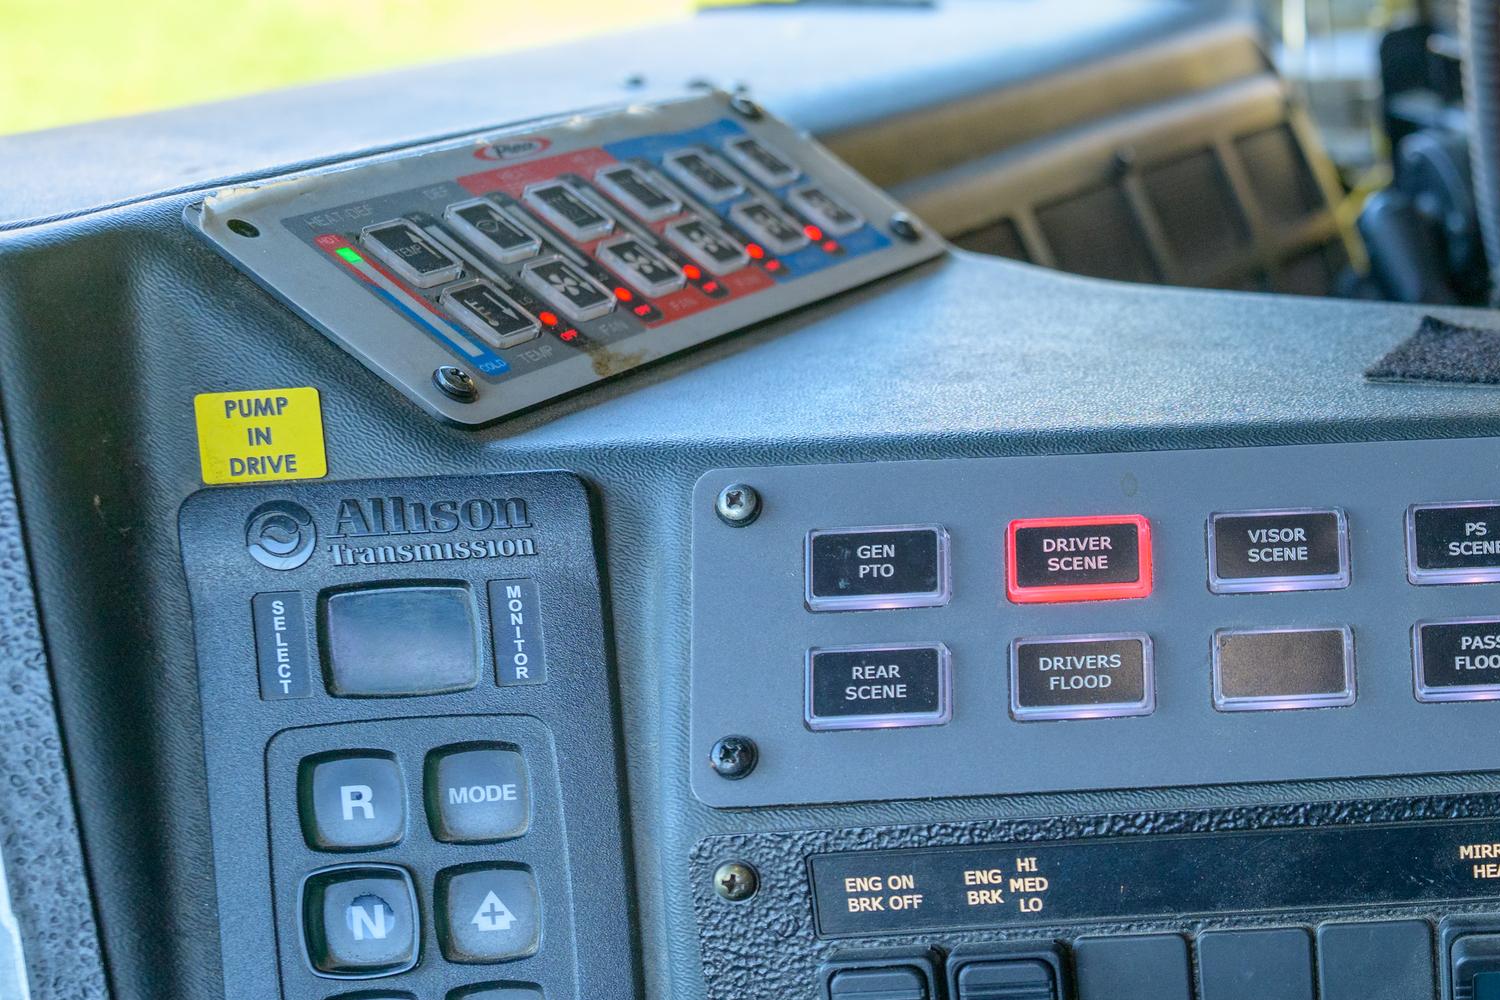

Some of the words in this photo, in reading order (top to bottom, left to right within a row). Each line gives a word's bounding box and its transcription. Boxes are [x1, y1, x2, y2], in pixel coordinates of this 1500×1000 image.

[518, 345, 553, 363] TEMP
[480, 359, 507, 373] COLD
[224, 396, 289, 420] PUMP
[248, 426, 272, 447] IN
[229, 454, 297, 477] DRIVE
[326, 496, 532, 538] Allison
[1247, 527, 1307, 544] VISOR
[1465, 521, 1487, 537] PS
[327, 536, 538, 566] Transmission
[856, 544, 895, 560] GEN
[1042, 536, 1113, 553] DRIVER
[1247, 546, 1308, 562] SCENE
[859, 563, 895, 579] PTO
[1047, 556, 1109, 572] SCENE
[506, 585, 529, 679] MONITOR
[271, 599, 290, 695] SELECT
[1038, 654, 1122, 672] DRIVERS
[851, 664, 901, 681] REAR
[1049, 674, 1112, 691] FLOOD
[845, 684, 907, 701] SCENE
[340, 784, 376, 820] R
[448, 784, 517, 805] MODE
[1016, 857, 1038, 872] HI
[845, 876, 882, 892] ENG
[887, 874, 914, 890] ON
[963, 869, 1002, 886] ENG
[1009, 877, 1049, 893] MED
[847, 896, 884, 913] BRK
[889, 894, 923, 911] OFF
[967, 889, 1004, 906] BRK
[1019, 897, 1043, 913] LO
[351, 904, 387, 941] N
